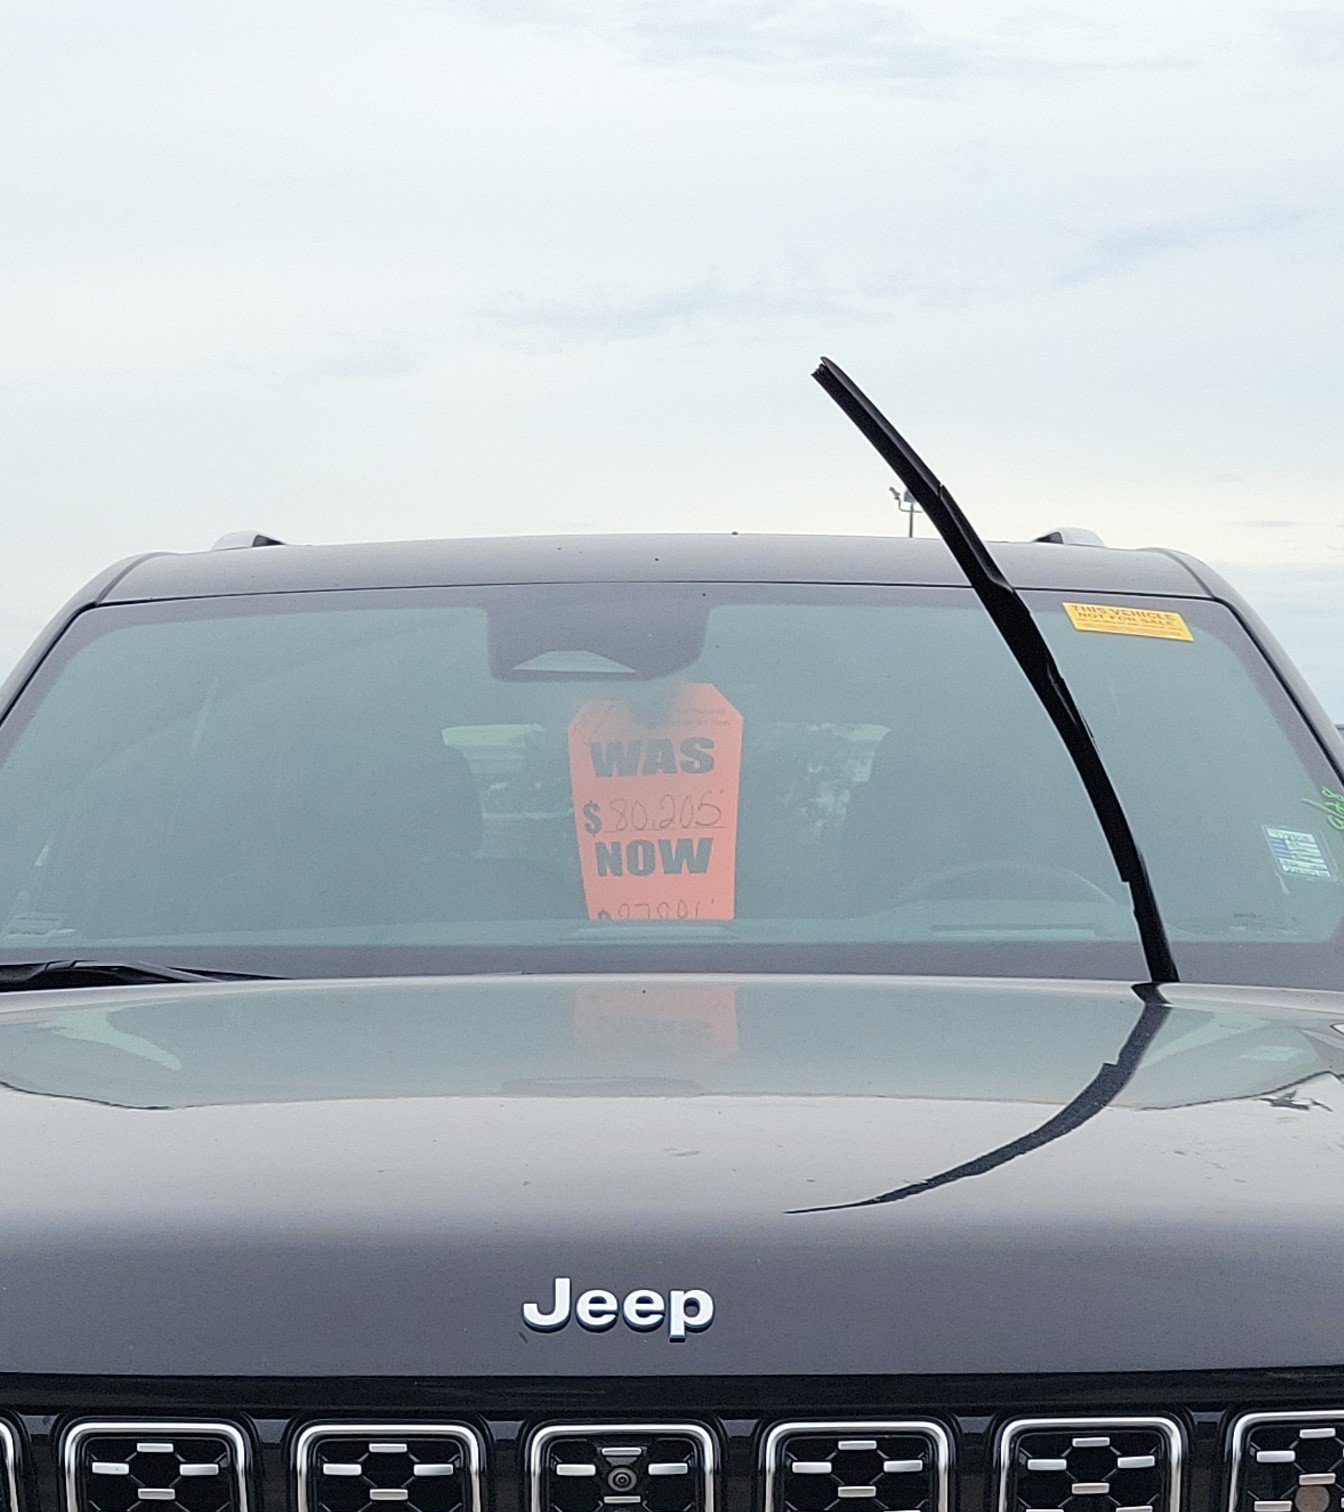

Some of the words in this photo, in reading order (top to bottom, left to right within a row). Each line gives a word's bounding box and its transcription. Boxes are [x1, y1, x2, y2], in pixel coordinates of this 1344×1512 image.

[1071, 604, 1107, 614] THIS
[1109, 608, 1175, 621] VEHICLE
[1140, 618, 1174, 626] SALE
[588, 737, 714, 777] WAS
[594, 837, 713, 877] NOW
[522, 1276, 715, 1343] Jeep
